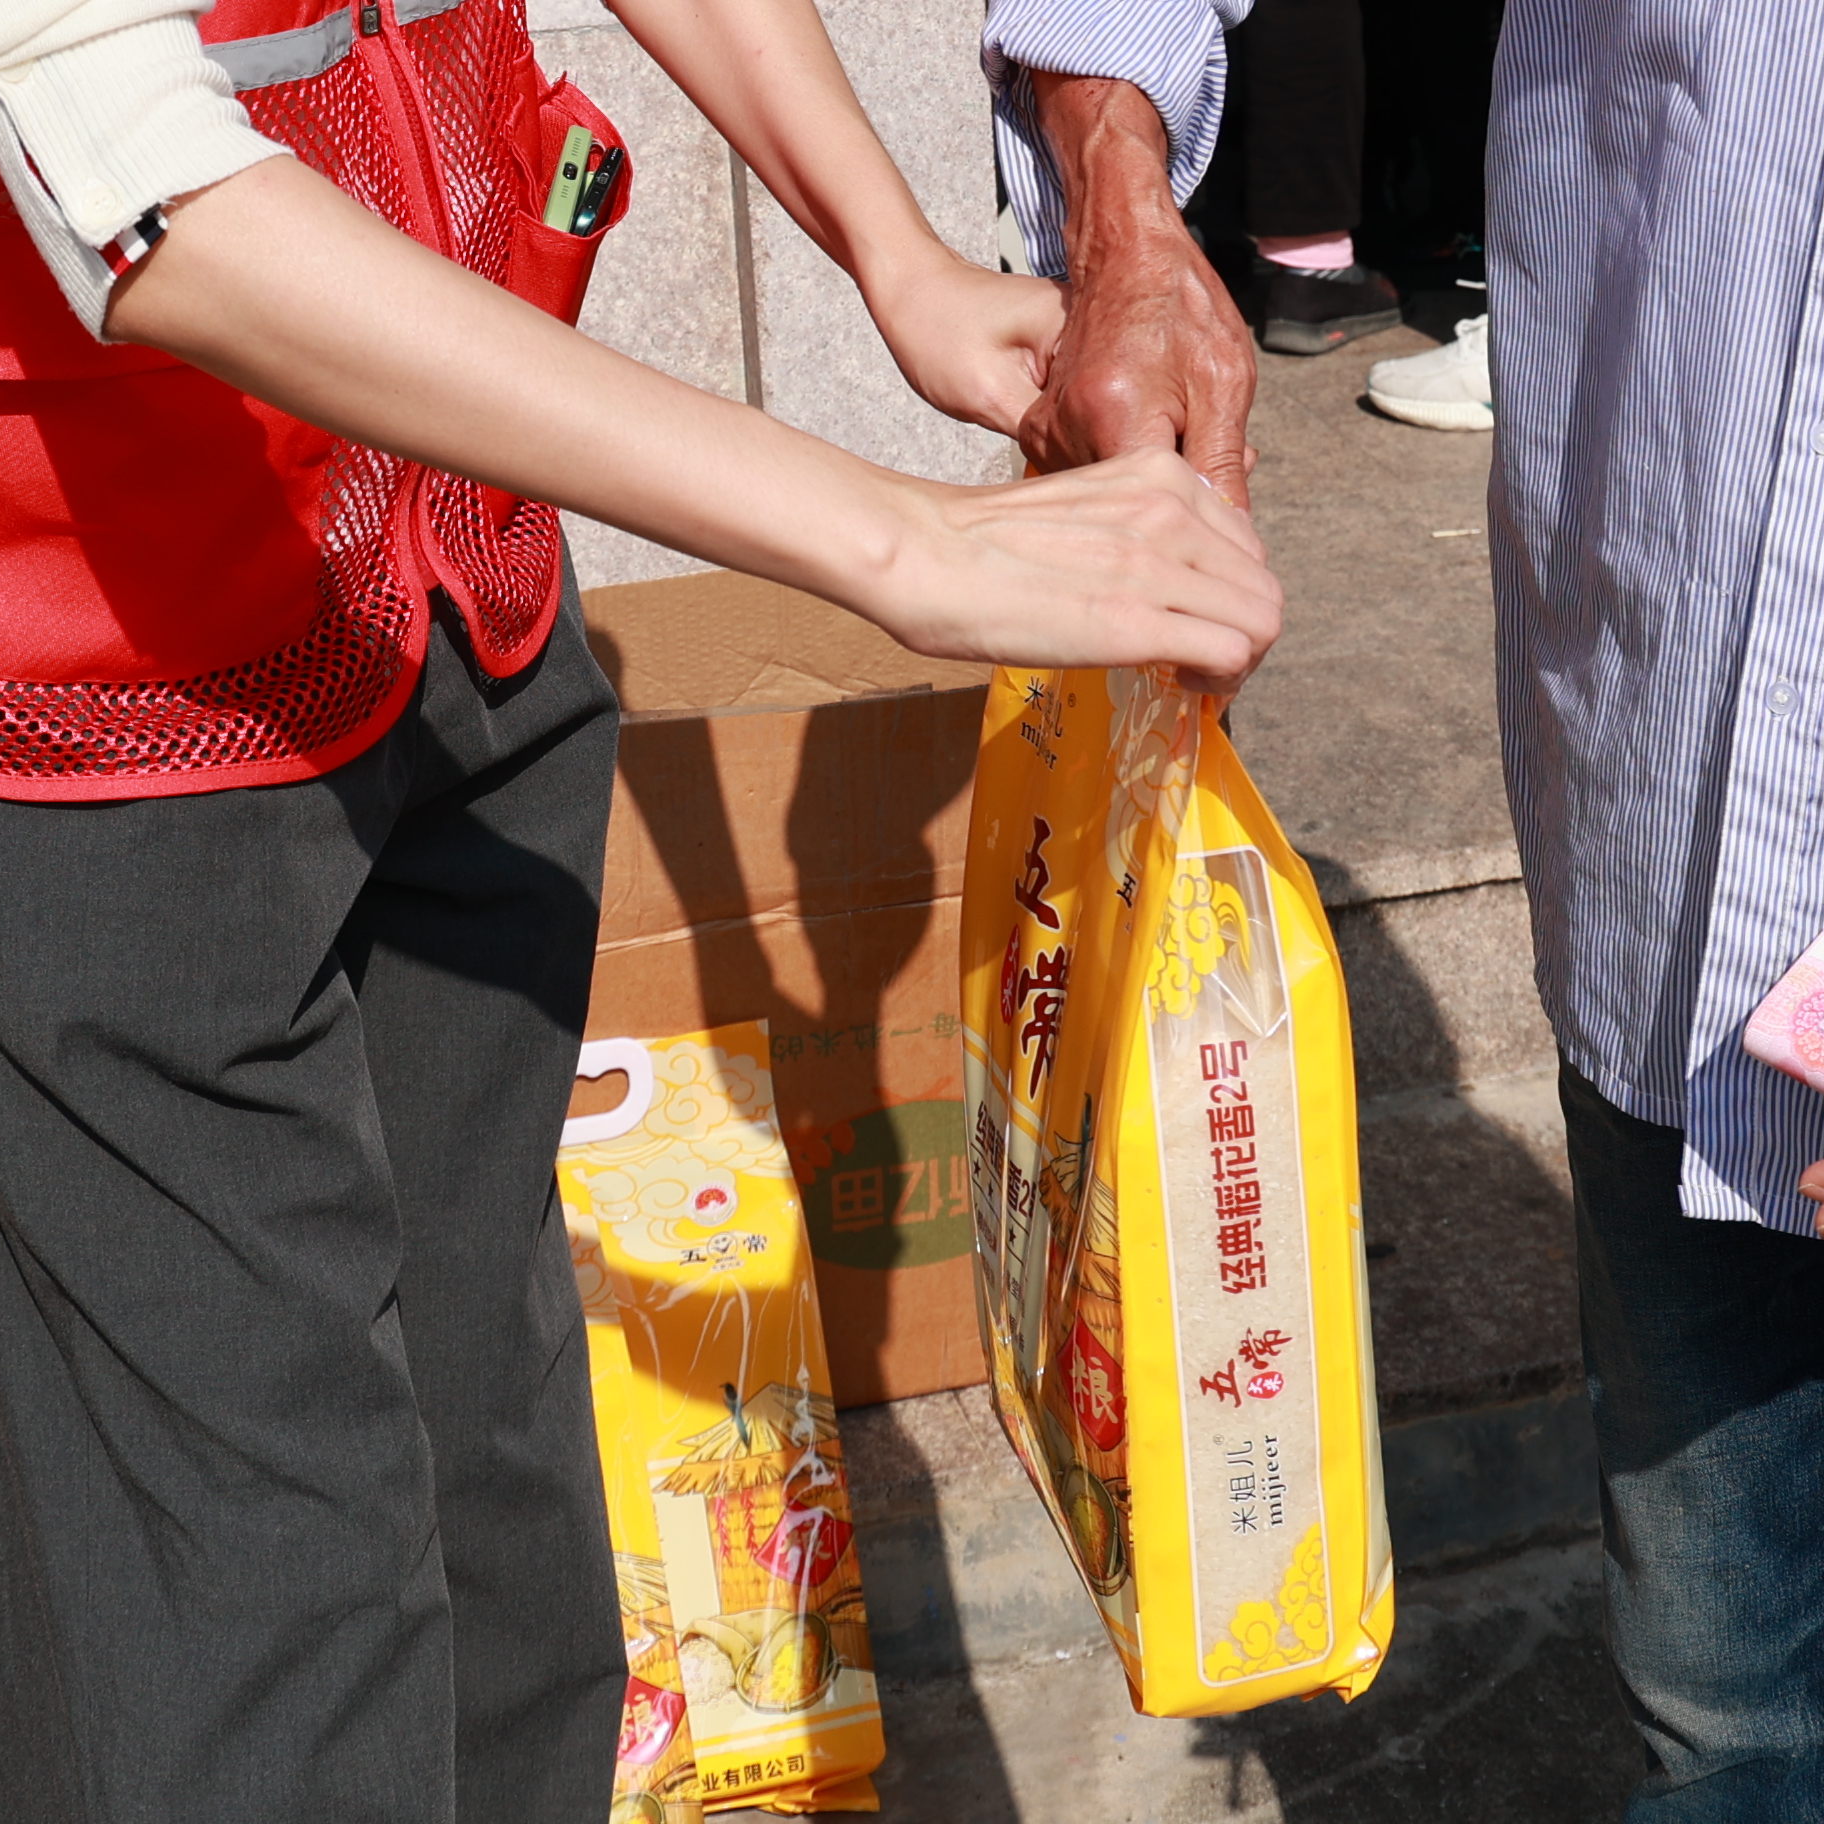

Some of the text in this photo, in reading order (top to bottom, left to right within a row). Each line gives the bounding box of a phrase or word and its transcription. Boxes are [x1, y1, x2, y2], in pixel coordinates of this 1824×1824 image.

[1198, 1038, 1267, 1296] 经典稻花香2号
[1198, 1327, 1295, 1409] 五常
[1226, 1439, 1260, 1535] 米姐儿
[1263, 1434, 1288, 1528] mijieer
[701, 1753, 806, 1794] 业有限公司
